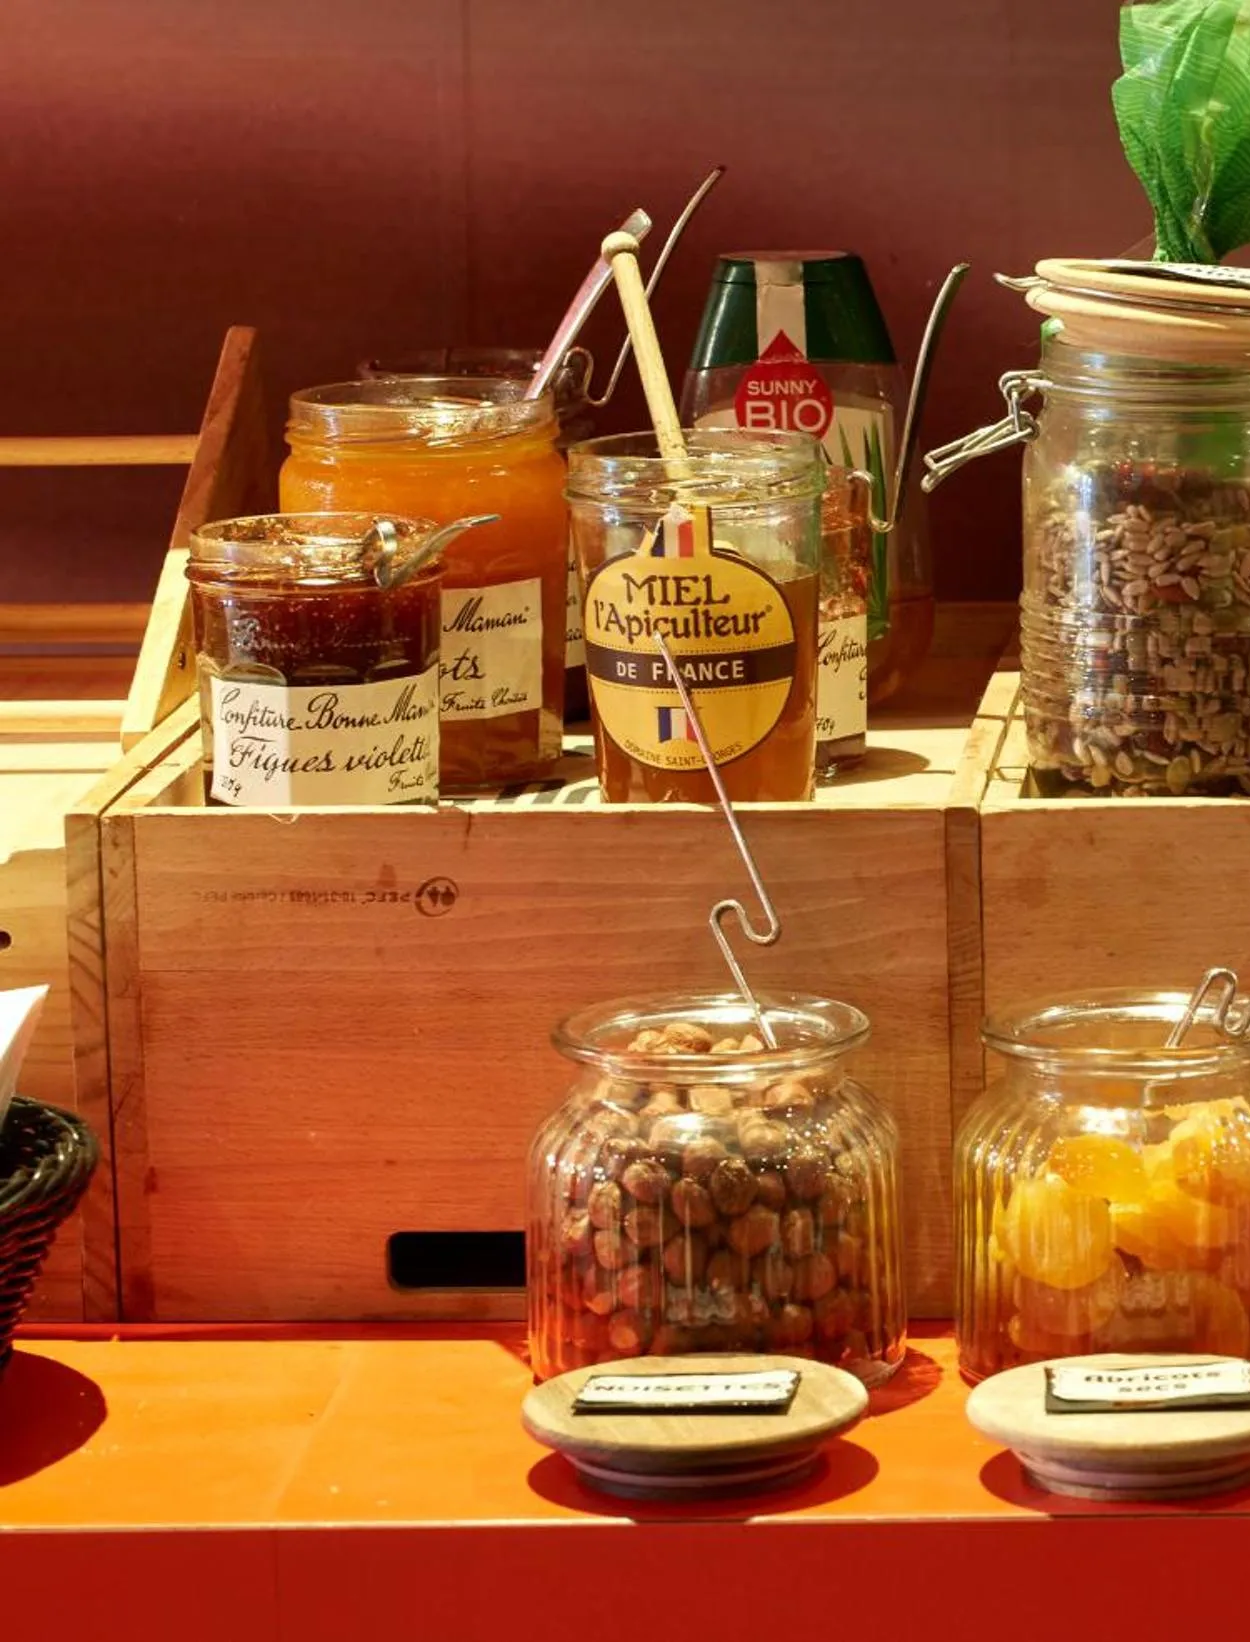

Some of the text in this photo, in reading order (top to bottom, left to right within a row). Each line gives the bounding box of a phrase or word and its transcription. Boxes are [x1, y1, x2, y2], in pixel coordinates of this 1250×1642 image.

[747, 380, 817, 396] SUNNY
[744, 399, 827, 433] BIO
[622, 573, 731, 607] MIEL
[442, 595, 527, 633] Maman
[593, 599, 767, 645] l'Apiculteur
[616, 661, 638, 679] DE
[817, 629, 867, 673] Confitur
[220, 687, 303, 734] Confiture
[302, 692, 380, 730] Bonne
[229, 736, 336, 782] Figues
